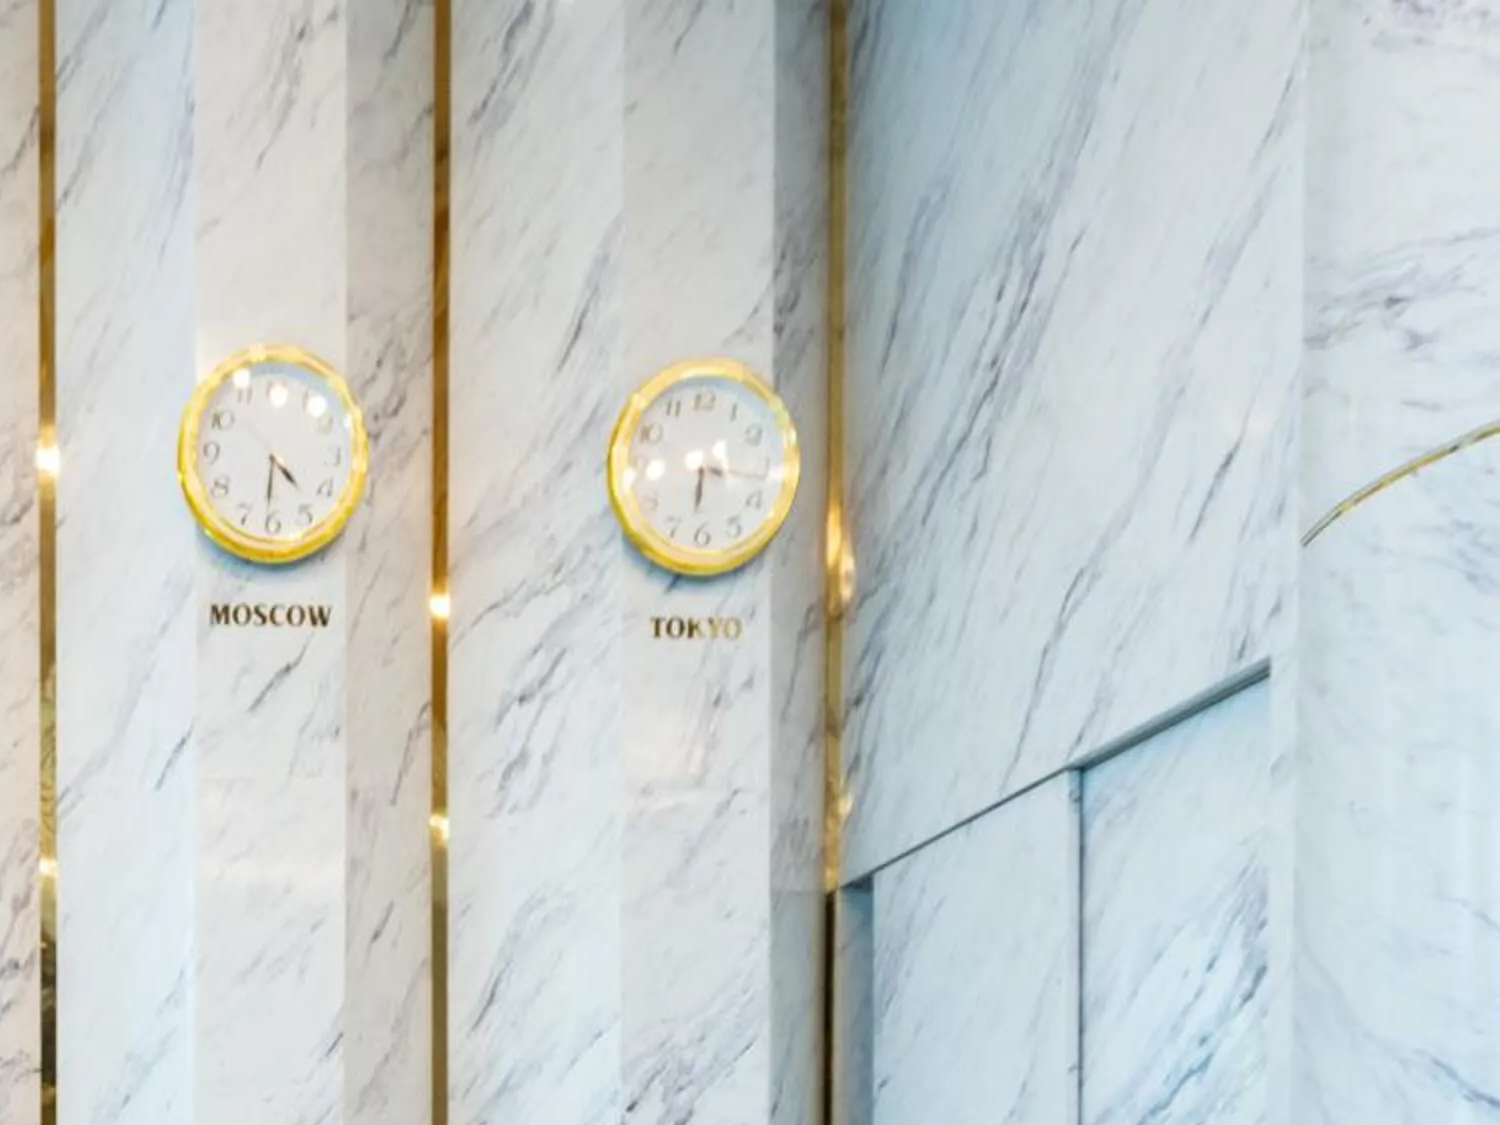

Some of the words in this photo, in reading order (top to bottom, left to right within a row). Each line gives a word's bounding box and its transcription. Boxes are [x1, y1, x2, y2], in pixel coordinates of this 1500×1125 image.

[664, 399, 682, 418] 11
[693, 392, 716, 412] 12
[730, 403, 738, 421] 1
[211, 411, 235, 430] 10
[640, 423, 663, 444] 10
[745, 426, 763, 446] 2
[203, 442, 220, 464] 9
[324, 446, 341, 466] 3
[210, 477, 229, 498] 8
[316, 478, 334, 498] 4
[745, 489, 762, 510] 4
[238, 503, 253, 526] 7
[265, 512, 282, 534] 6
[296, 504, 314, 526] 5
[664, 515, 682, 538] 7
[694, 523, 711, 547] 6
[725, 515, 742, 538] 5
[209, 604, 332, 627] MOSCOW
[651, 616, 743, 640] TOKYO
